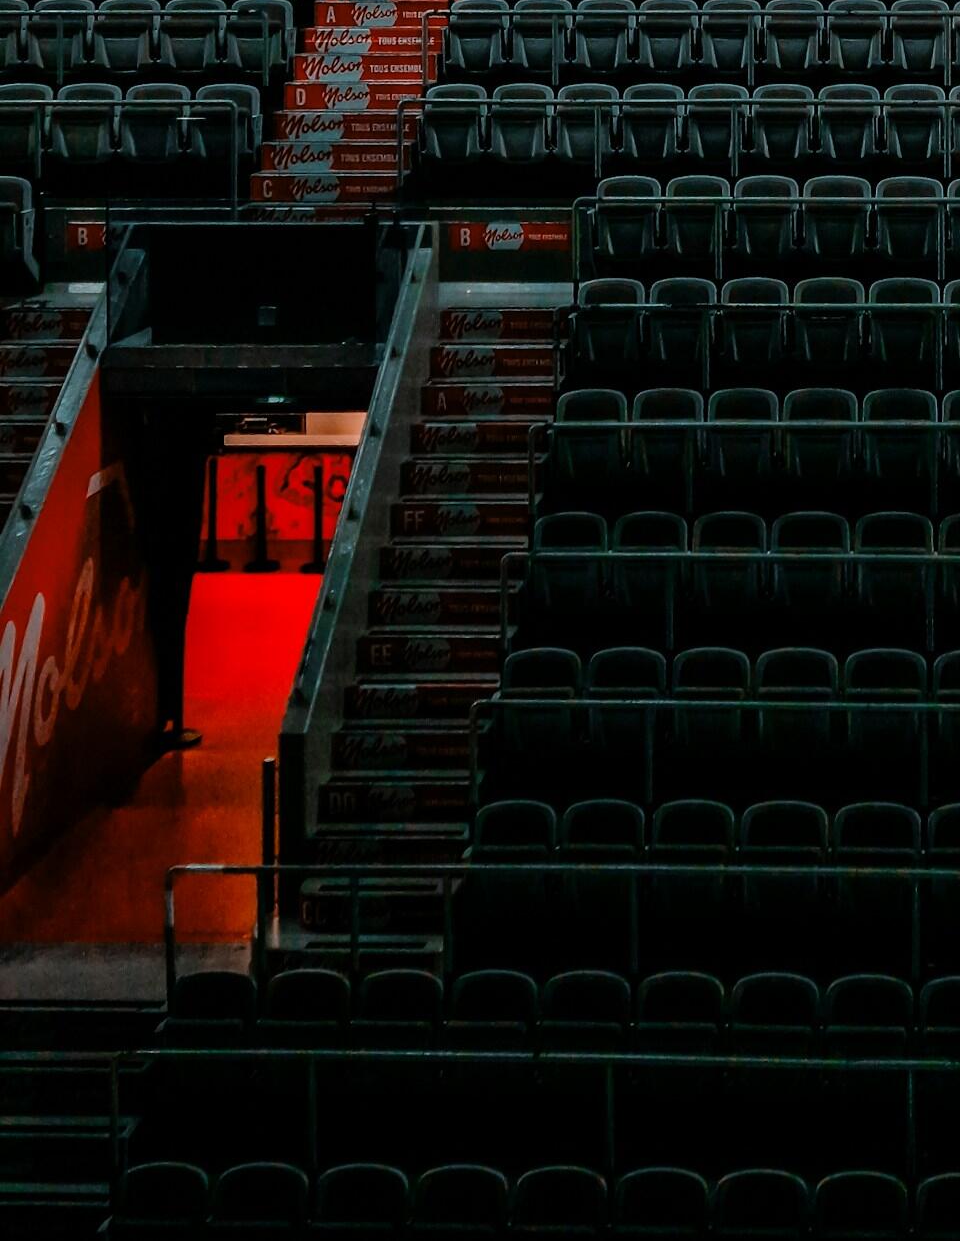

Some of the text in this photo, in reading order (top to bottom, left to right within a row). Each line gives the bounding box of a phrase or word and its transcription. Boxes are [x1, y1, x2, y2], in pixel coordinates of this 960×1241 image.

[326, 6, 336, 23] A
[296, 89, 306, 105] D
[263, 180, 272, 198] C
[77, 227, 88, 246] B
[460, 228, 471, 246] B
[438, 392, 447, 411] A
